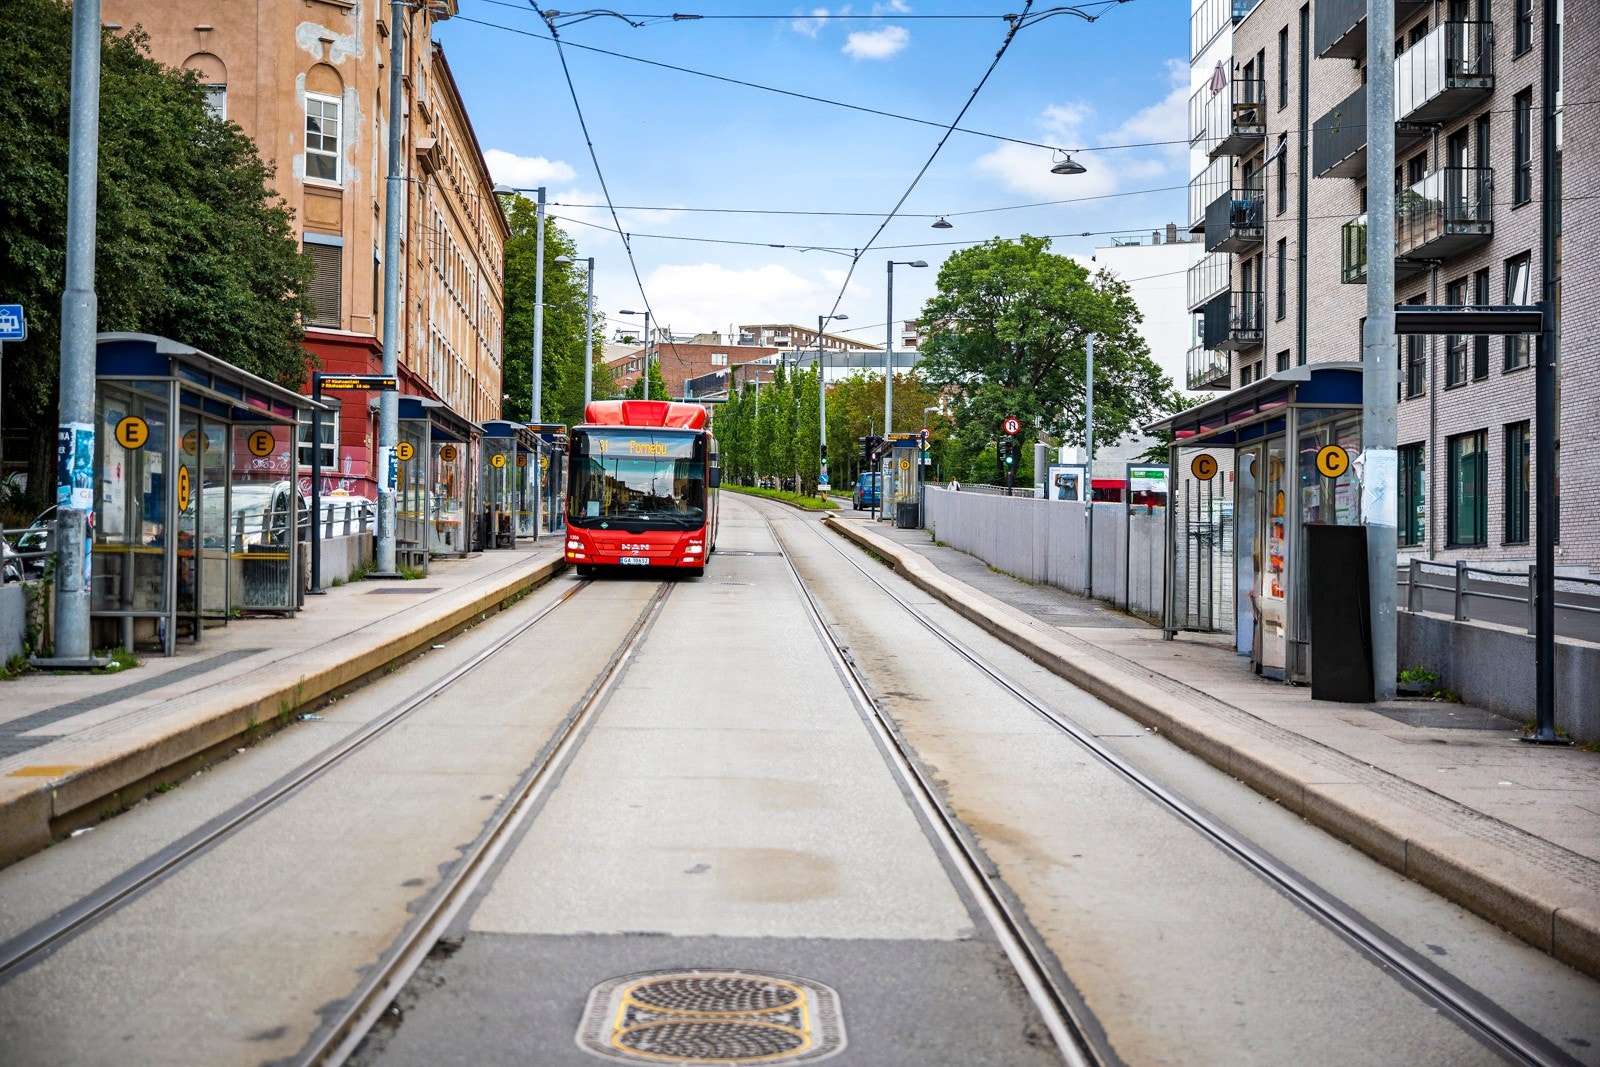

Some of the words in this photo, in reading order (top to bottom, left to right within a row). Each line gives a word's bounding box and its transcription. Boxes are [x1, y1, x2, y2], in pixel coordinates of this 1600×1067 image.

[126, 423, 138, 442] E
[256, 436, 266, 451] E
[400, 446, 408, 456] E
[599, 440, 609, 453] 31
[629, 440, 667, 455] Fornebu
[446, 448, 452, 458] E
[495, 456, 502, 464] F
[1325, 451, 1340, 470] C
[518, 457, 524, 465] F
[1198, 459, 1210, 474] C
[182, 474, 186, 502] E
